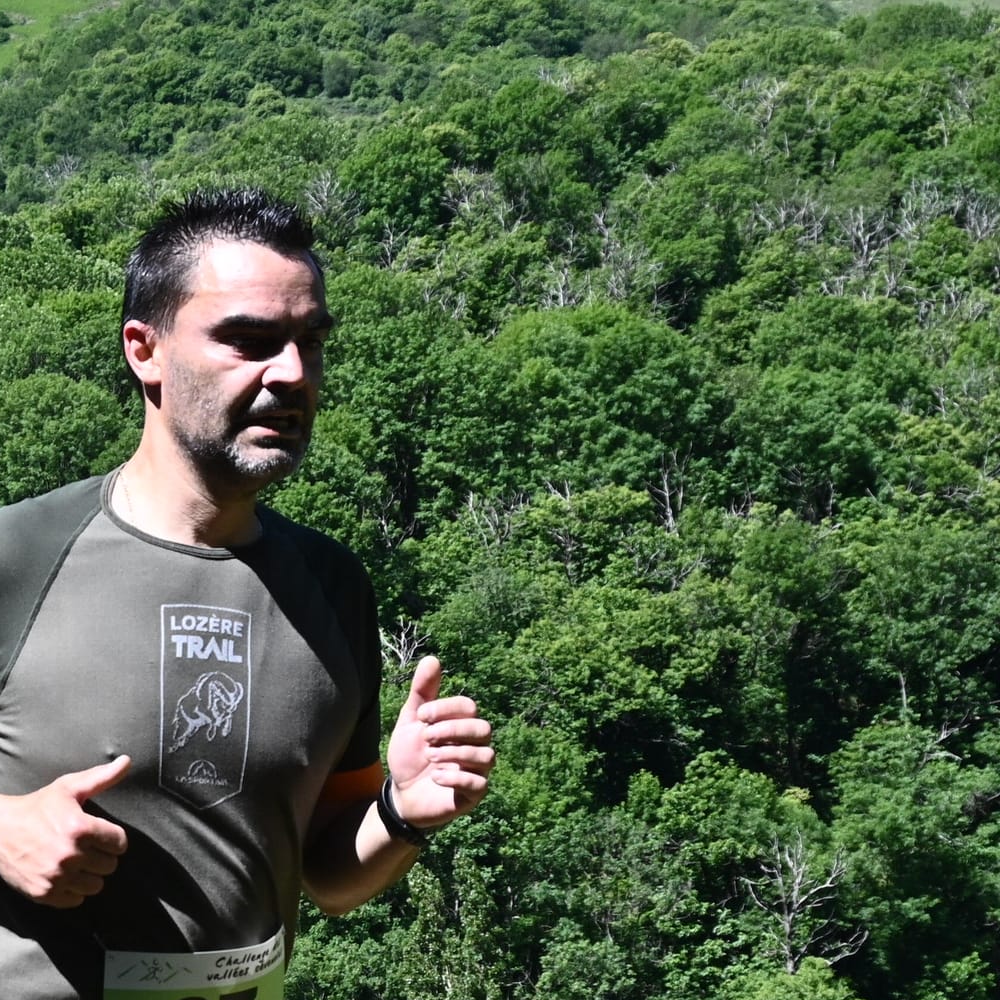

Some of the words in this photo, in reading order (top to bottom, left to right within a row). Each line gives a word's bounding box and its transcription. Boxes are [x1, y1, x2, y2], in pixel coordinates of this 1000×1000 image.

[170, 614, 244, 637] LOZÈRE
[171, 635, 243, 663] TRAIL
[207, 967, 249, 981] vallées
